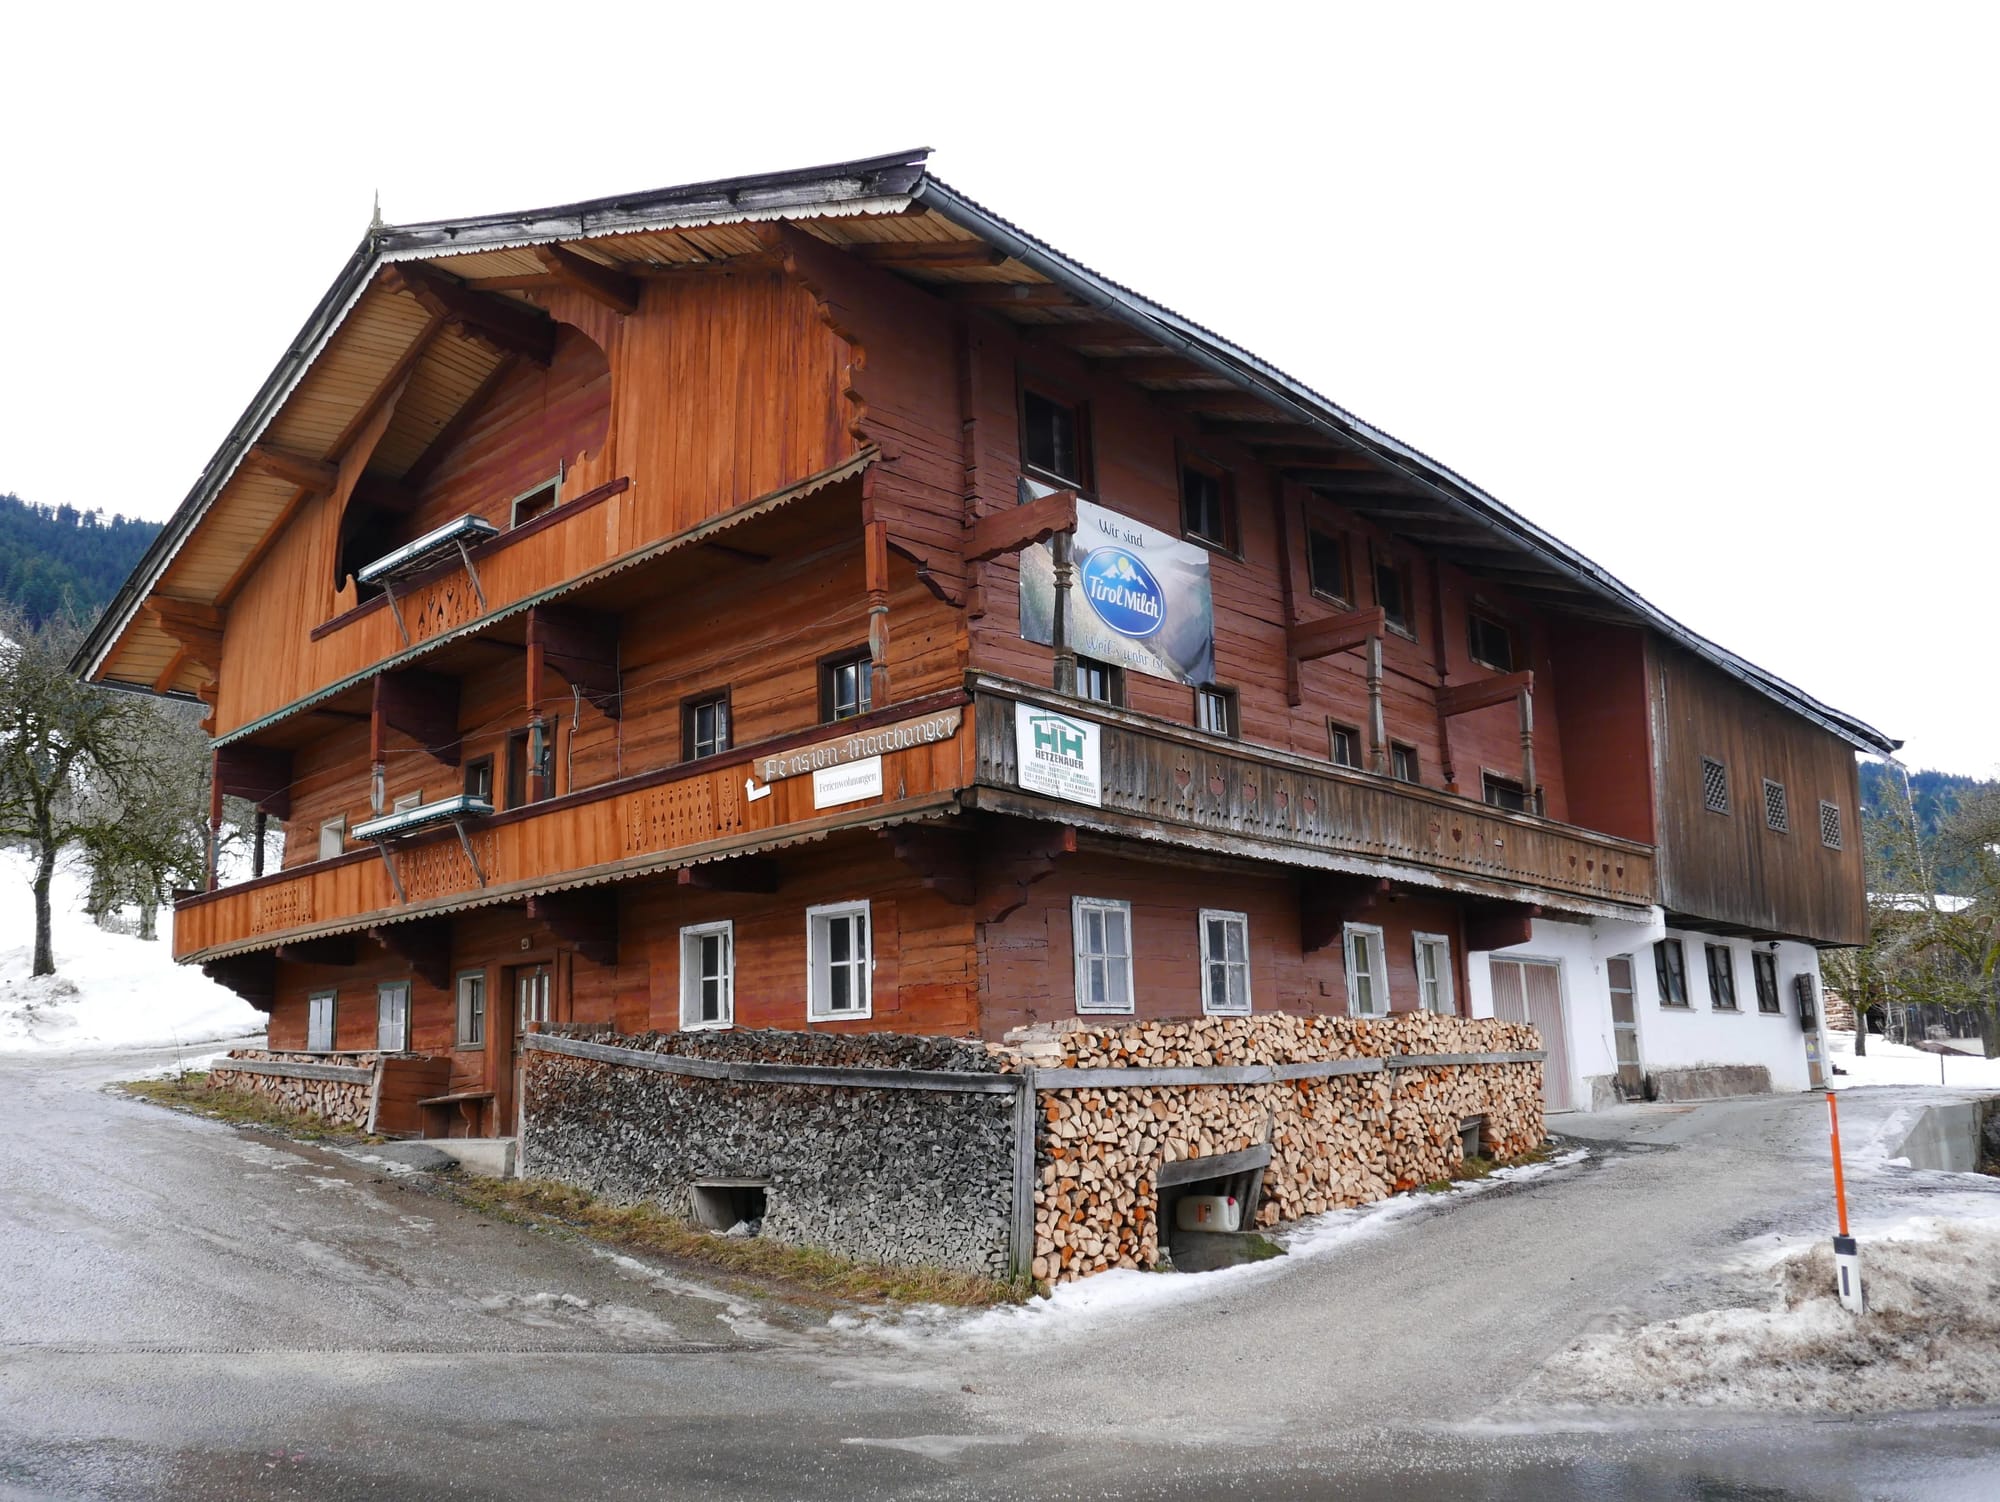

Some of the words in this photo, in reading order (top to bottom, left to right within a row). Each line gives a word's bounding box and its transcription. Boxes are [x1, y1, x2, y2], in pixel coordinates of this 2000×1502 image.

[1099, 518, 1120, 538] Wir
[1123, 529, 1144, 549] sind
[1089, 576, 1123, 605] Tirol
[1124, 590, 1159, 619] Milch
[1033, 723, 1083, 760] HH
[1035, 749, 1084, 770] HETZENAUER
[819, 772, 877, 793] Ferienwohnungen
